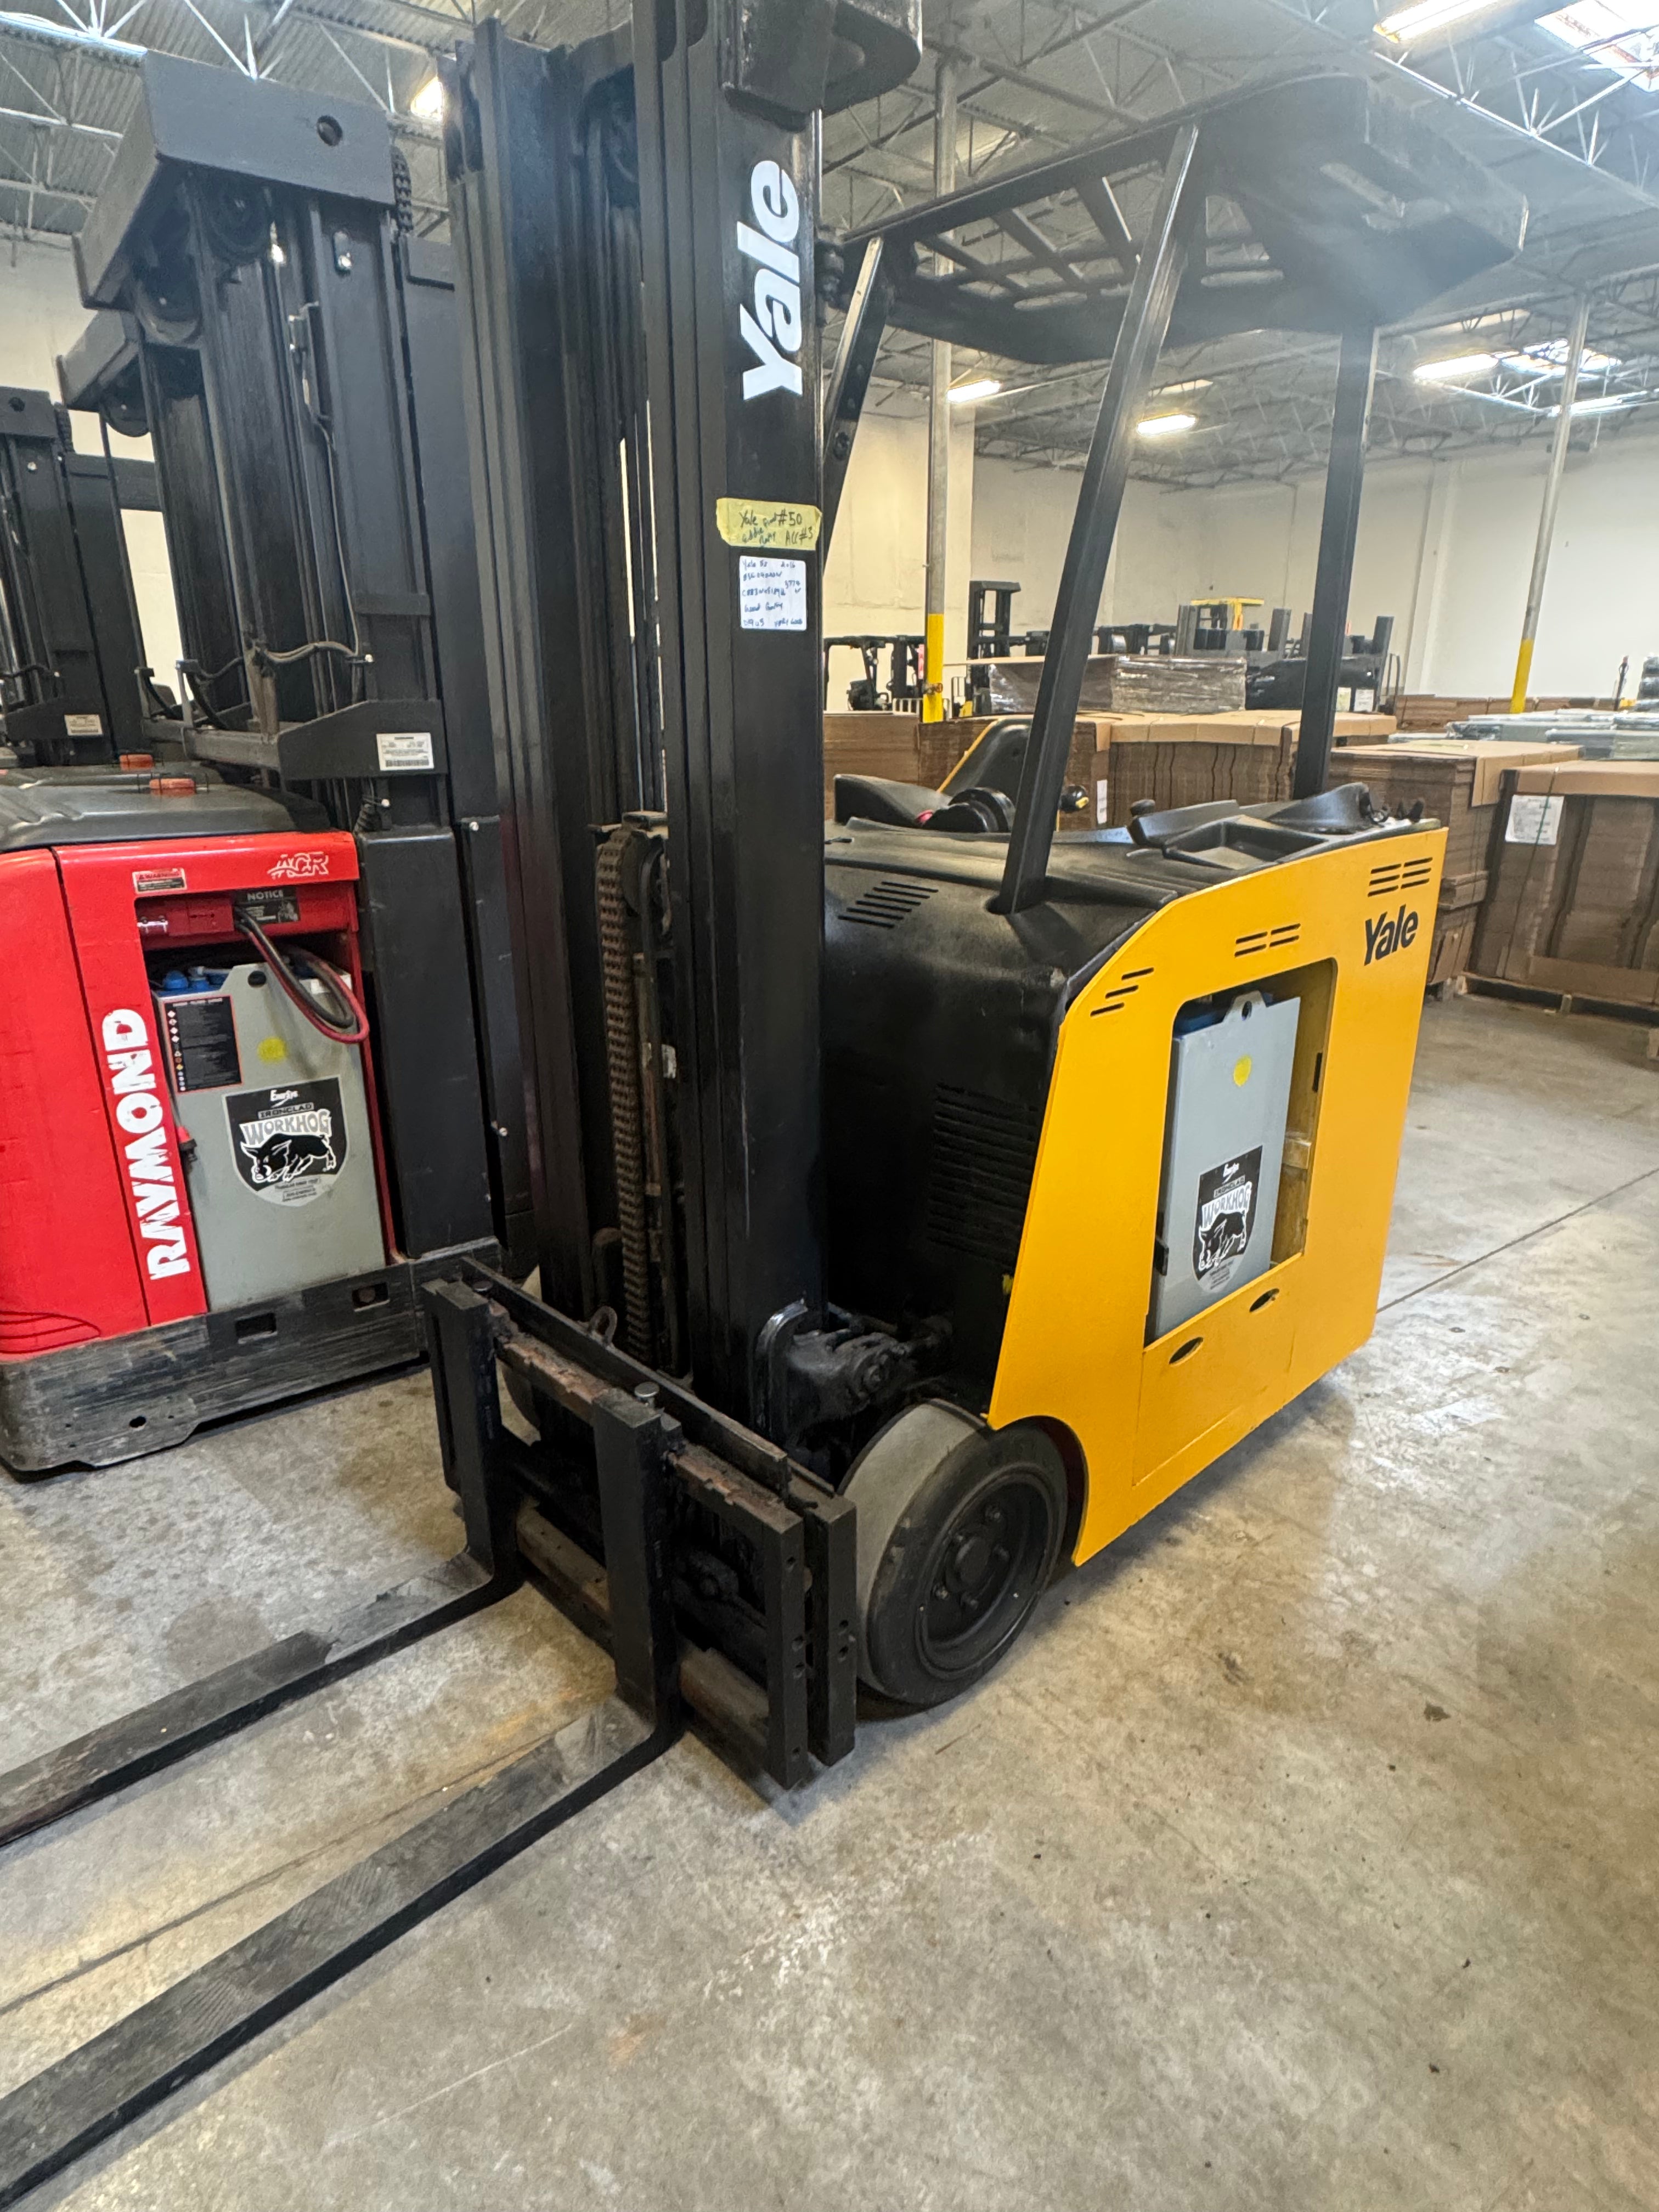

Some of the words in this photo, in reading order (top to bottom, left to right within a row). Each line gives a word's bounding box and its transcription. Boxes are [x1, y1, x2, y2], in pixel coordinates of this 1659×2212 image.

[737, 160, 803, 400] Yale
[247, 889, 284, 901] NOTICE
[1364, 903, 1419, 967] Yale
[244, 1110, 330, 1146] WORKHOG
[260, 1104, 312, 1118] IRONCLAD
[102, 1009, 190, 1280] RAYMOND
[1203, 1184, 1251, 1228] WORKHOG
